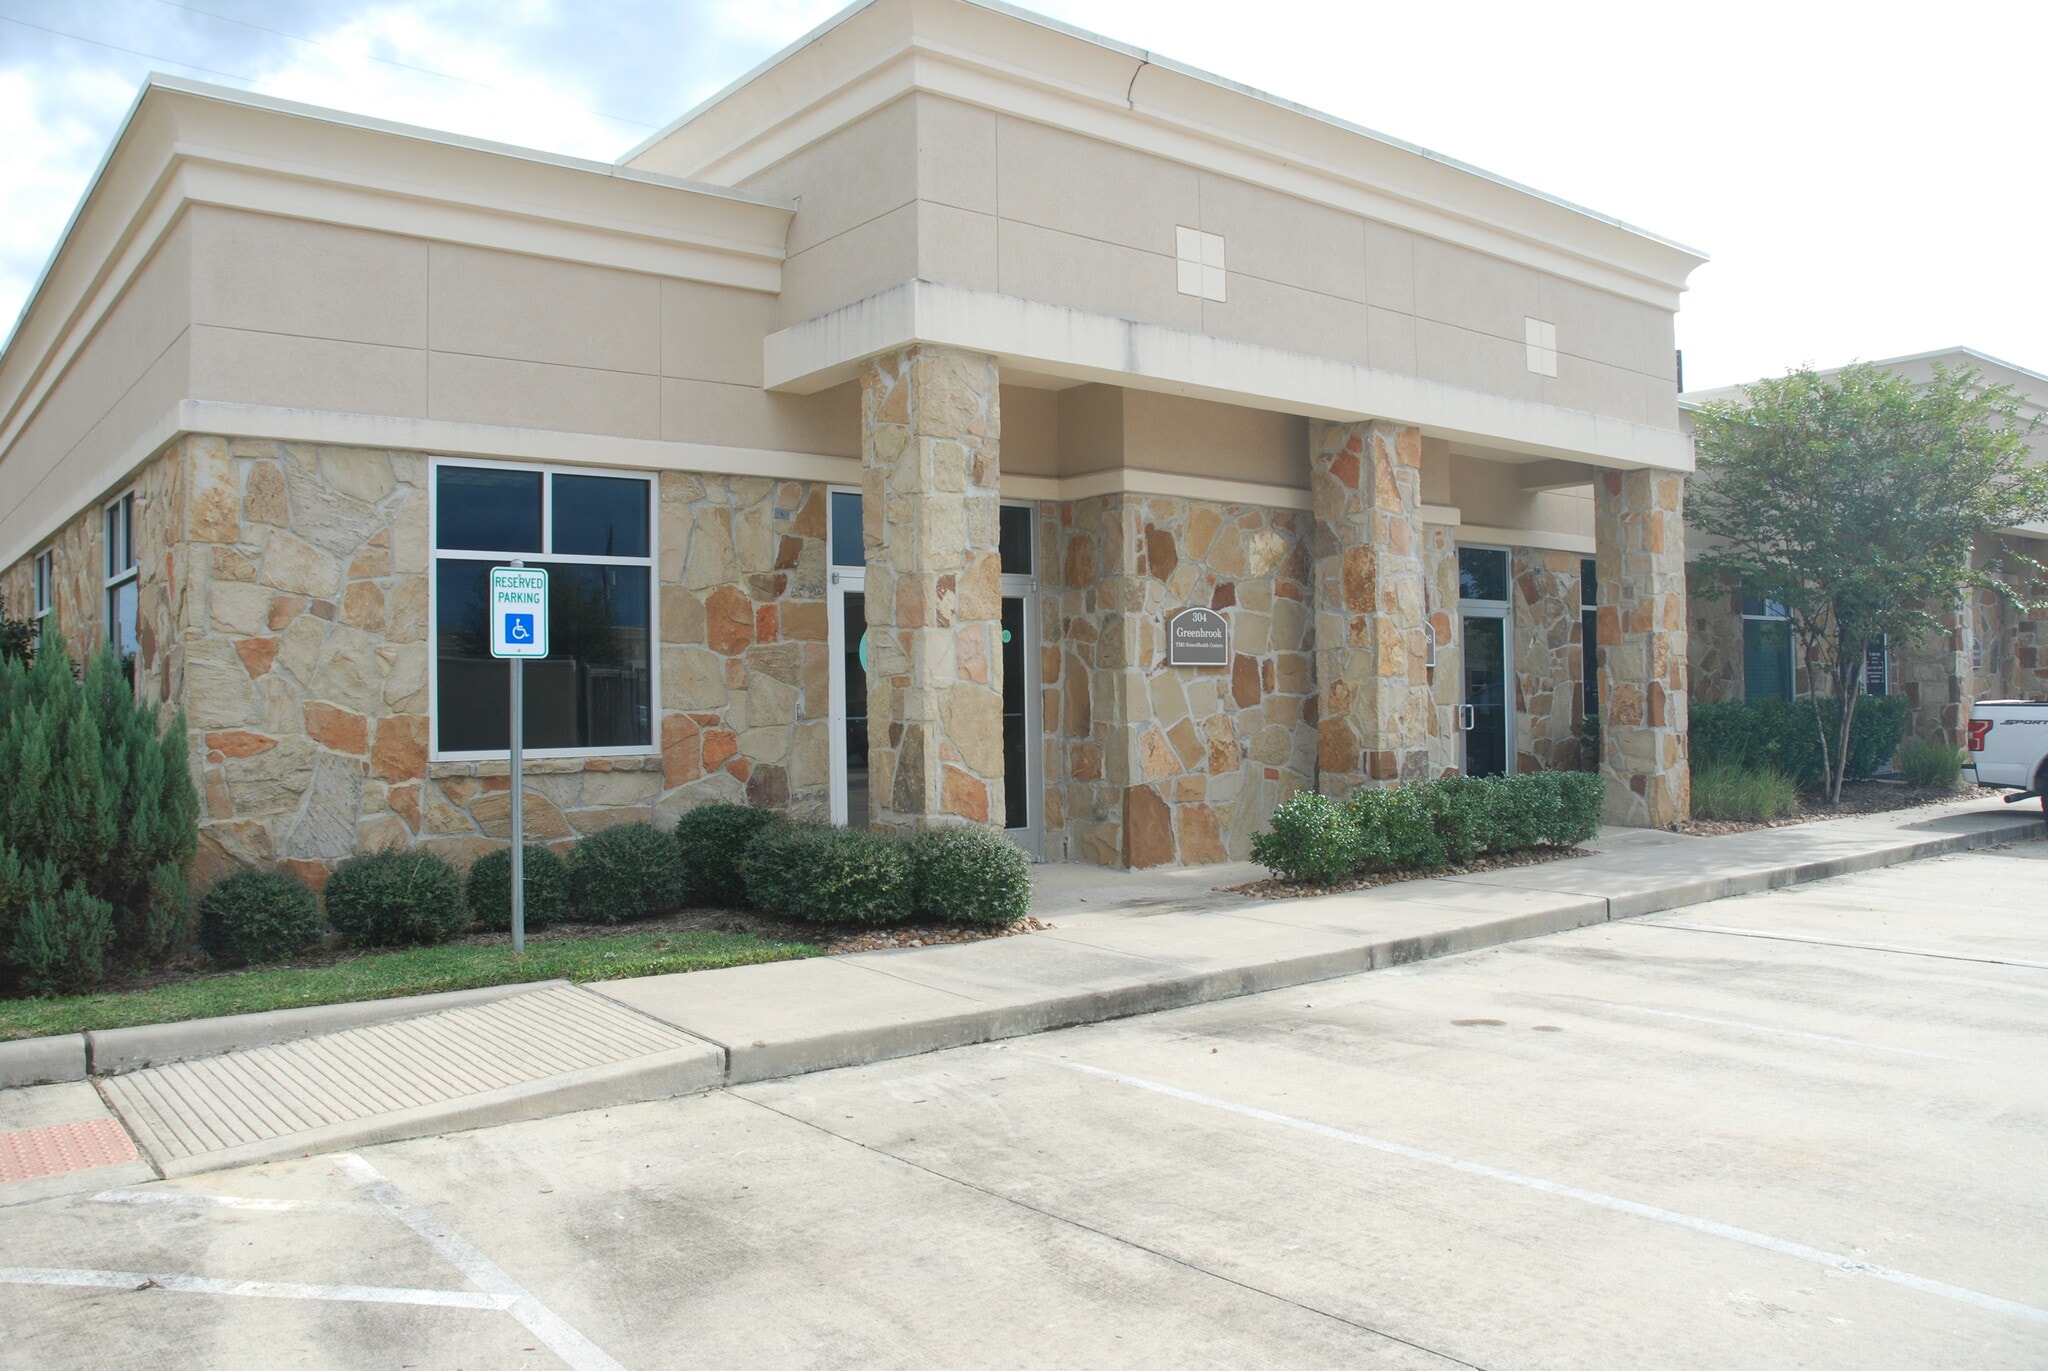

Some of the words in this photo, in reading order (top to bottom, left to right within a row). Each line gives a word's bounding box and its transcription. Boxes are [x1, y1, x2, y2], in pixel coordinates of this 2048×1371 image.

[495, 576, 543, 589] RESERVED
[498, 591, 540, 604] PARKING
[1192, 612, 1207, 622] 304
[1176, 626, 1223, 638] Greenbrook
